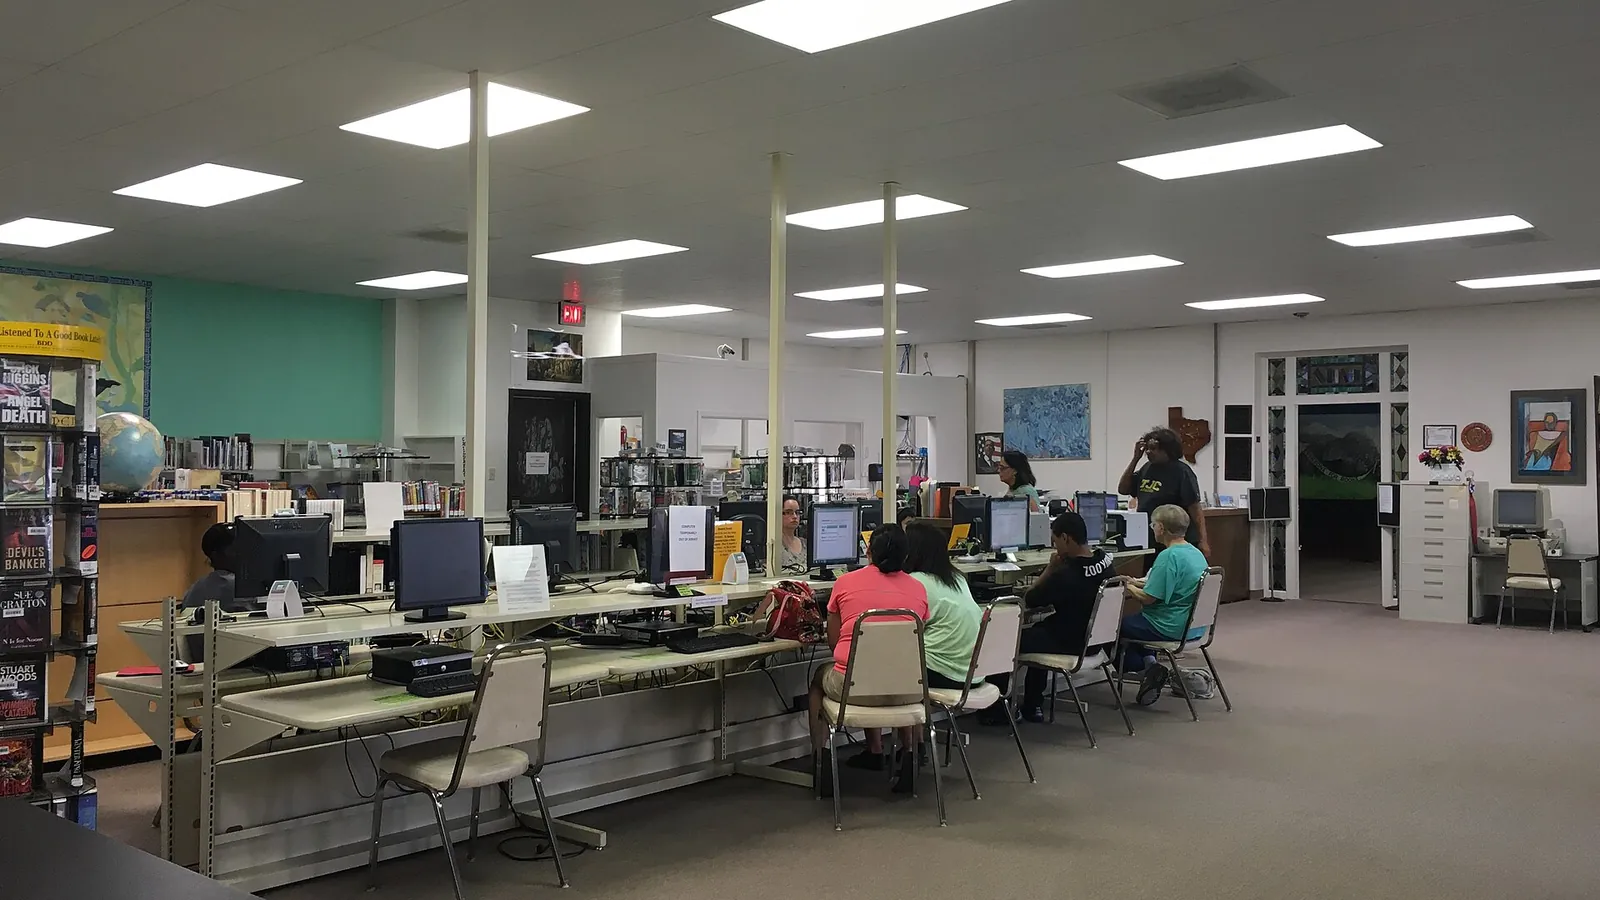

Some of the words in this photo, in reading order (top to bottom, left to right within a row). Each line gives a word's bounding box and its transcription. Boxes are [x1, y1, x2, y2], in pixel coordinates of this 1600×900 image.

[564, 305, 582, 324] EXIT
[34, 328, 44, 338] To
[47, 330, 52, 338] A
[54, 330, 72, 340] Good
[74, 332, 88, 342] Book
[2, 372, 46, 385] HIGGINS
[7, 395, 42, 408] ANGEL
[2, 408, 46, 424] DEATH
[1140, 479, 1162, 492] TJC
[8, 546, 44, 558] DEVIL'S
[6, 558, 46, 570] BANKER
[14, 590, 33, 600] SUE
[0, 598, 46, 609] GRAFTON
[0, 664, 35, 674] STUART
[0, 672, 37, 682] WOODS
